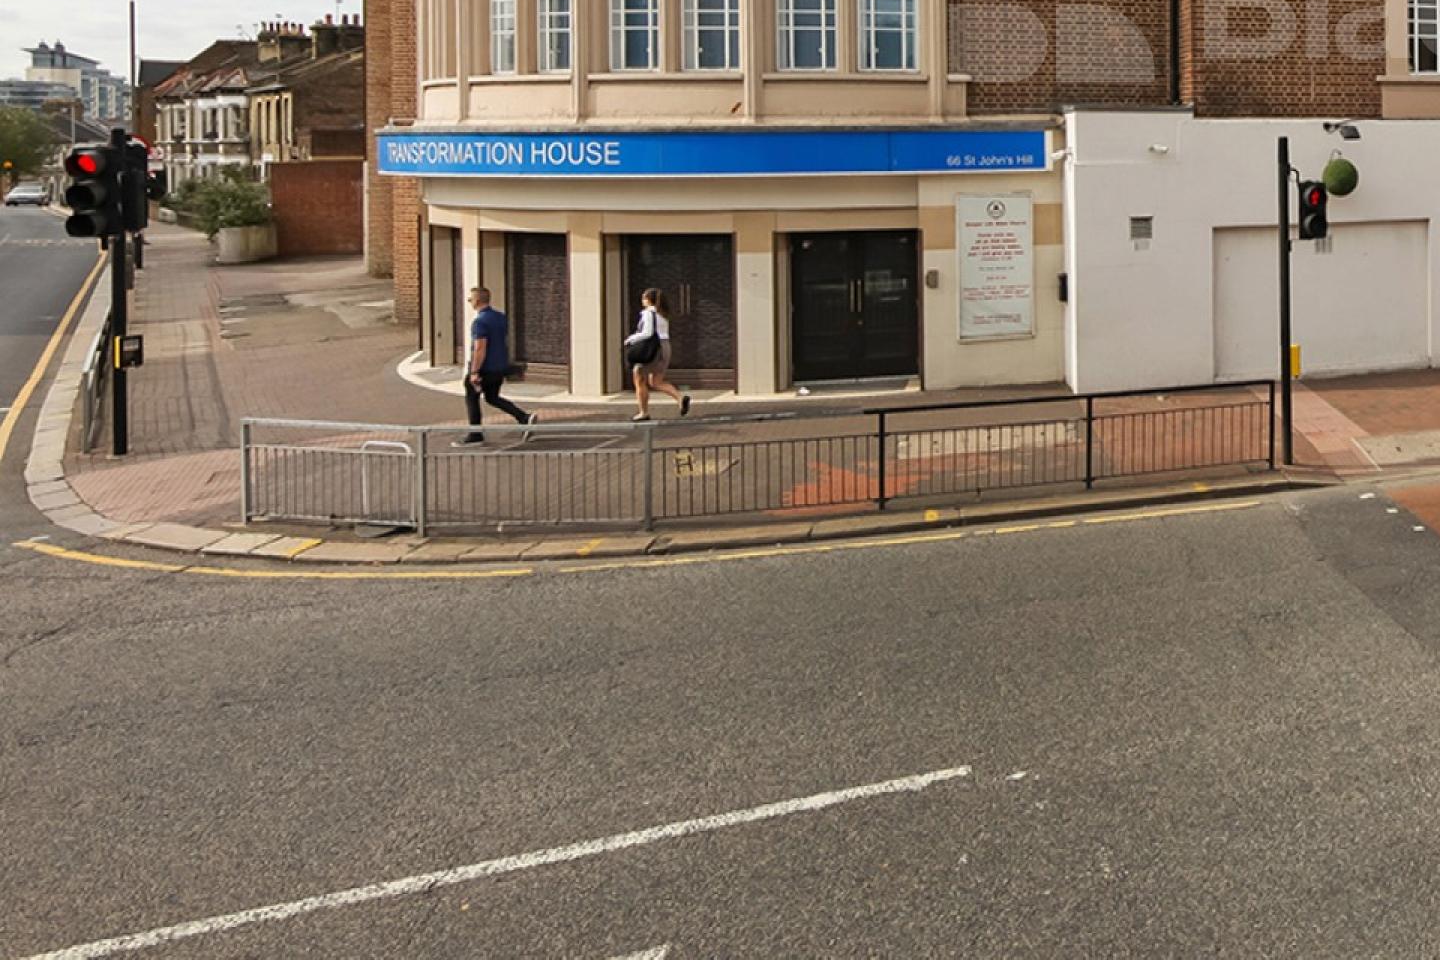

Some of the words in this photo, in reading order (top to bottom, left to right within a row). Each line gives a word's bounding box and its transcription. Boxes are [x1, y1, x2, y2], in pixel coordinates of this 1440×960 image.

[387, 141, 523, 166] TRANSFORMATION
[530, 141, 620, 166] HOUSE
[963, 154, 976, 166] St
[1016, 154, 1034, 166] Hill
